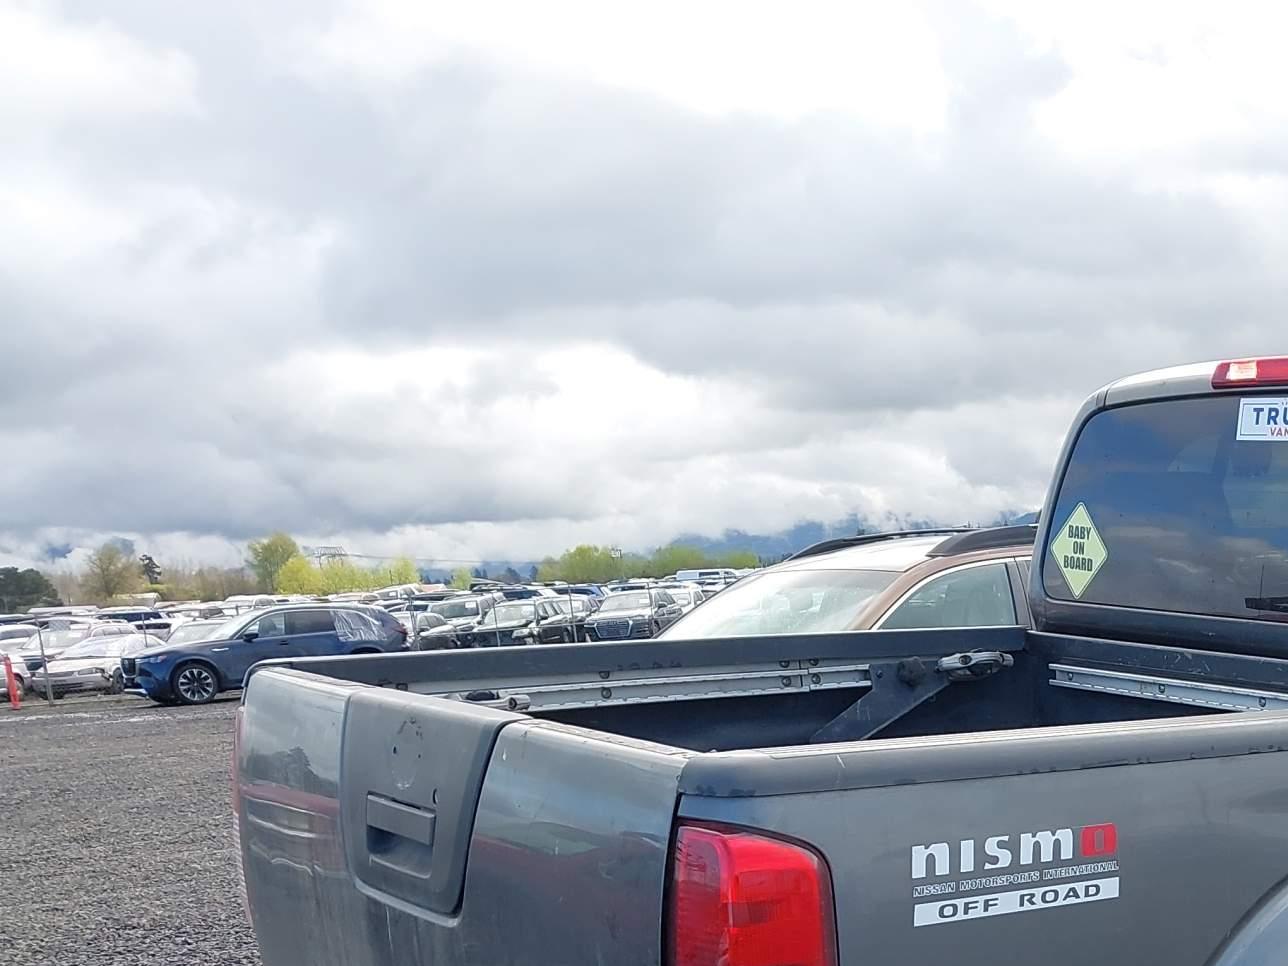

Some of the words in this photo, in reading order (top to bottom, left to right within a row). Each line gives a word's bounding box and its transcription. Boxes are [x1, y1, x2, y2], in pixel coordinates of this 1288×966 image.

[1068, 524, 1091, 540] BABY
[1073, 541, 1085, 555] ON
[1063, 555, 1093, 572] BOARD
[913, 882, 956, 898] NISSAN
[959, 871, 1040, 892] MOTORSPORTS
[1042, 860, 1120, 880] INTERNATIONAL
[938, 897, 1000, 919] OFF
[1018, 883, 1101, 907] ROAD
